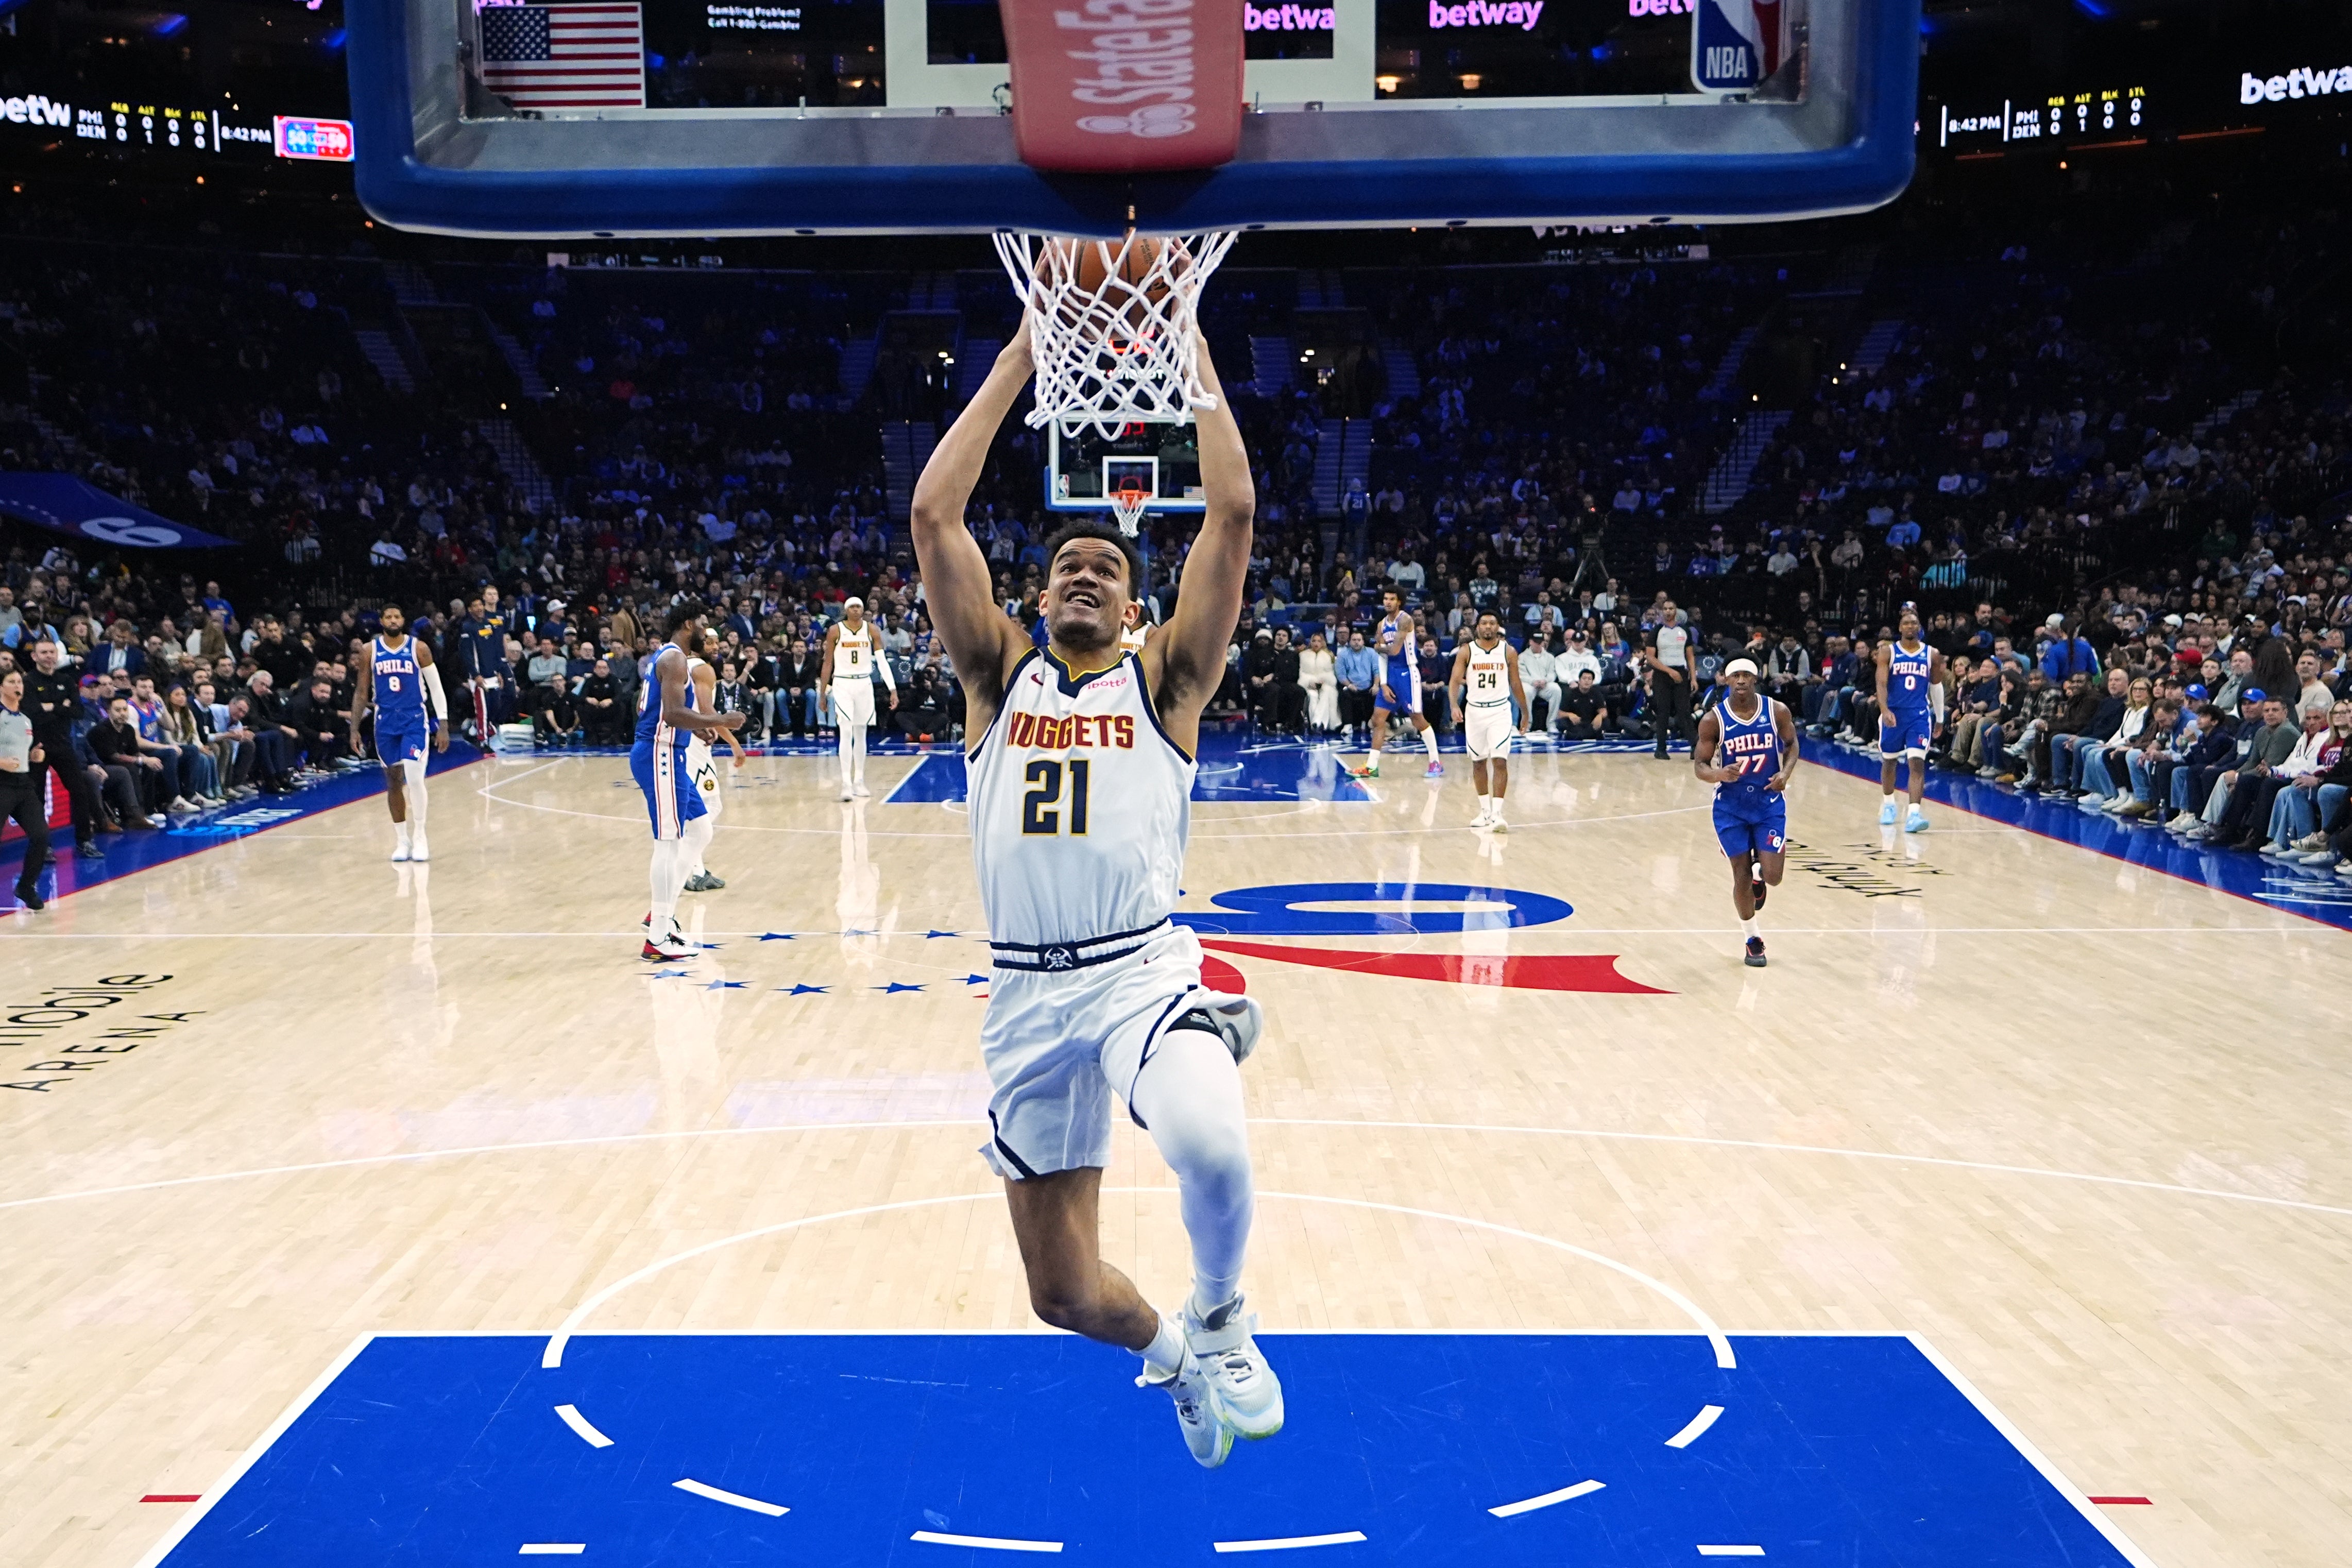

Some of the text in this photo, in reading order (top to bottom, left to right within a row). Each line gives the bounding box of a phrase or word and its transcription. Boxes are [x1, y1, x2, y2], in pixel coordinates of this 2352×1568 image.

[707, 5, 800, 19] Gambling Problem?
[1429, 0, 1544, 31] betway
[708, 18, 727, 28] Call
[1706, 46, 1748, 79] NBA
[2240, 66, 2352, 104] betwa
[2051, 107, 2061, 121] 0
[2077, 104, 2087, 117] 0
[2104, 101, 2114, 114] 0
[2131, 98, 2141, 111] 0
[115, 113, 127, 127] 0
[142, 116, 153, 130] 0
[168, 118, 179, 133] 0
[194, 121, 204, 135] 0
[221, 126, 272, 143] 8:42 PM
[1949, 115, 2001, 133] 8:42 PM
[2012, 112, 2140, 139] DEN 0 1 0 0
[76, 123, 206, 149] DEN 0 1 0 0
[375, 659, 414, 675] PHILA
[851, 650, 858, 664] 8
[1893, 662, 1927, 677] PHILA
[389, 676, 401, 692] 8
[1088, 676, 1127, 690] ibotta
[1478, 672, 1496, 689] 24
[1904, 675, 1916, 690] 0
[1007, 711, 1134, 750] NUGGETS
[1724, 733, 1773, 755] PHILA
[1735, 754, 1767, 775] 77
[1021, 759, 1091, 837] 21
[0, 1010, 207, 1092] ARENA
